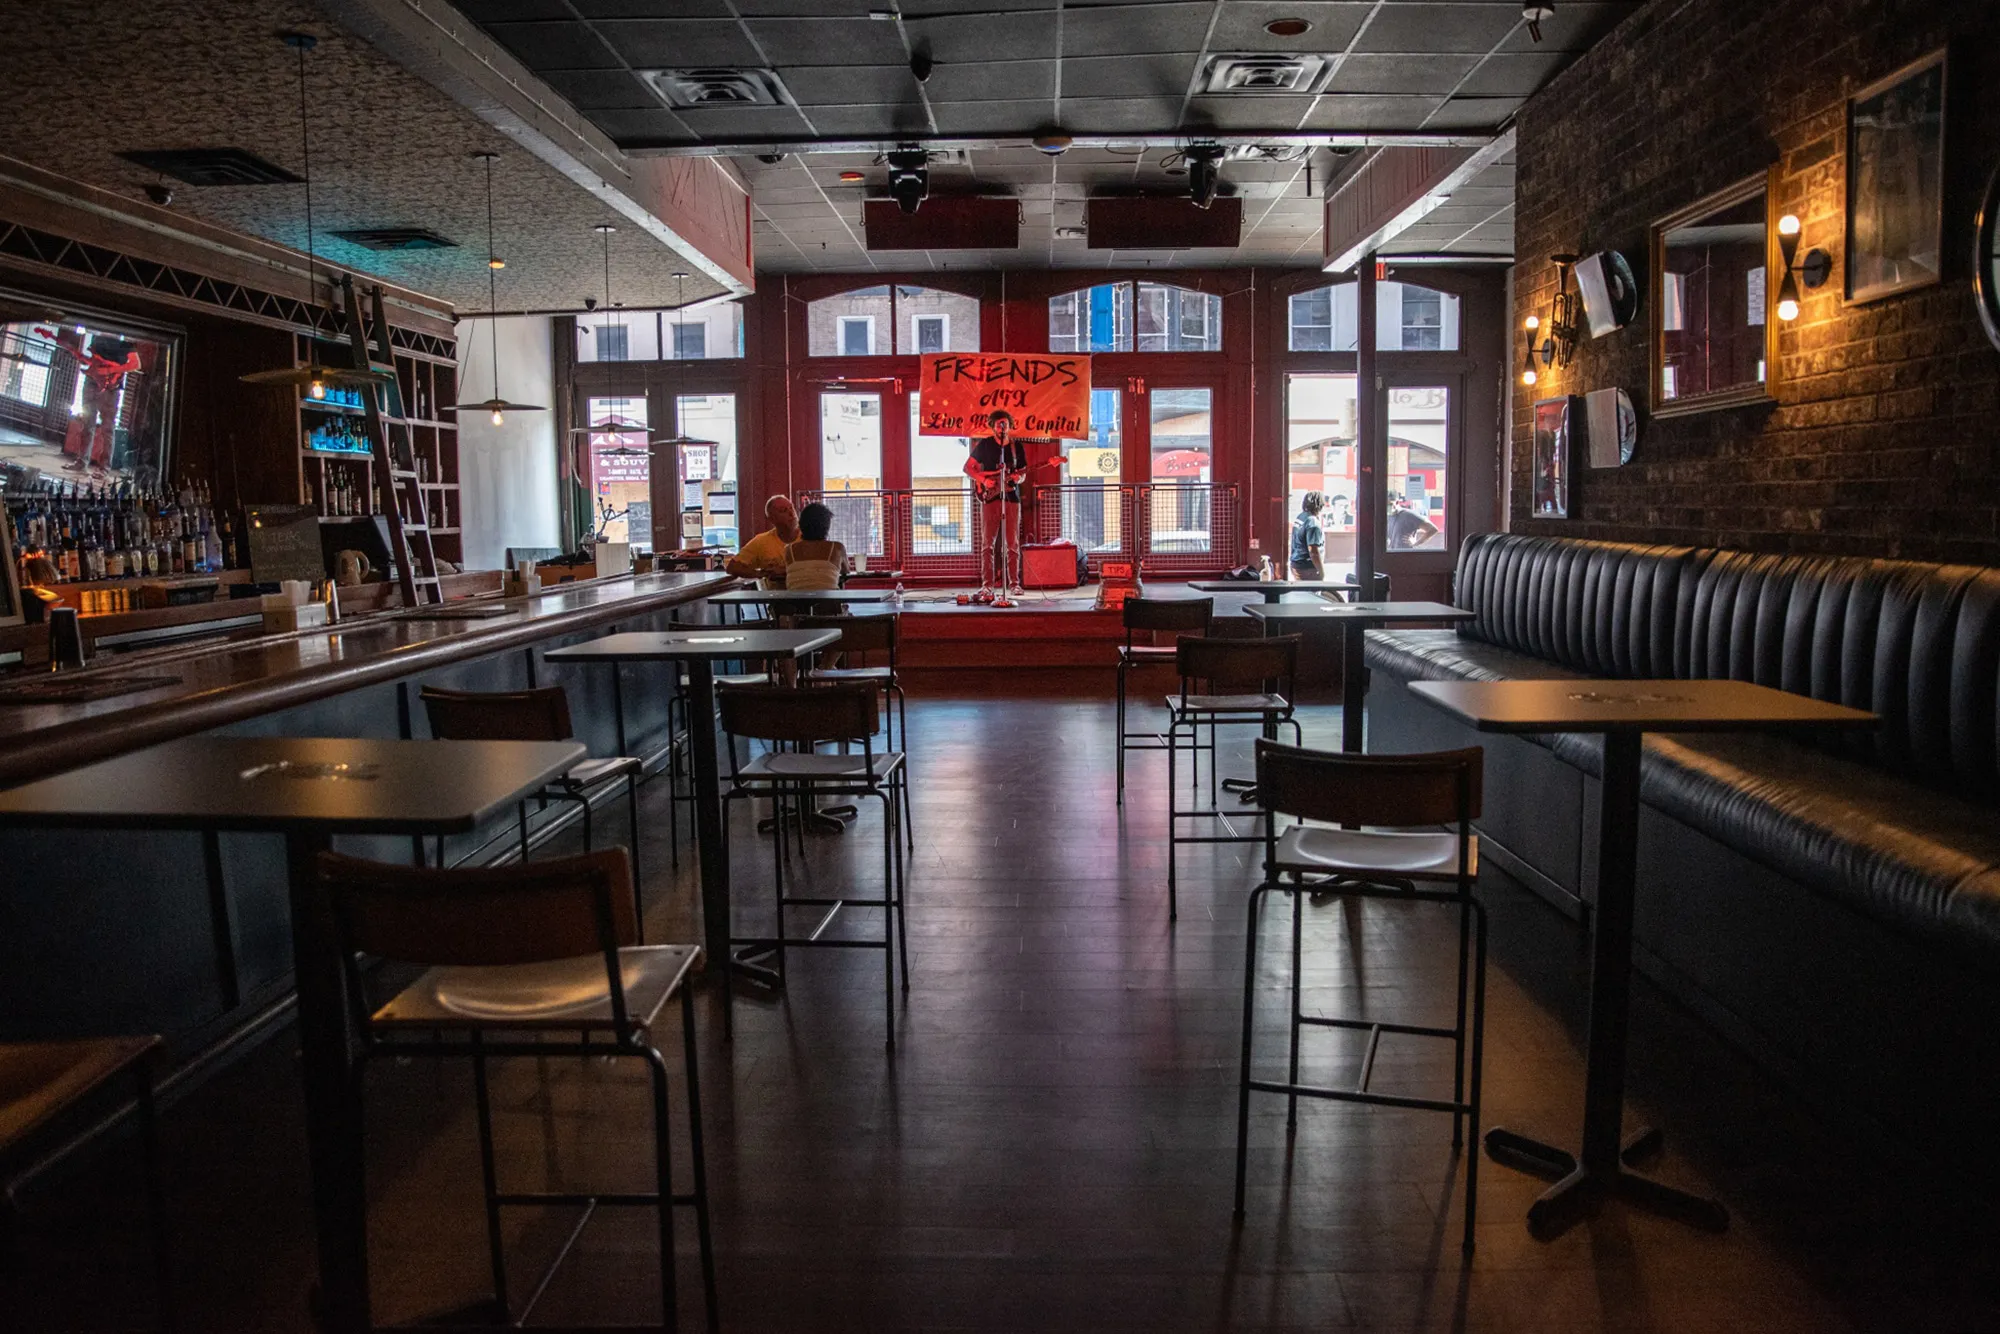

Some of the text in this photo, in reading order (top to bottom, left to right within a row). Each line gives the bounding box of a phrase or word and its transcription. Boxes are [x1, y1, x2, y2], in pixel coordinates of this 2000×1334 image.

[933, 356, 1078, 386] FRIENDS
[980, 388, 1029, 407] ATX
[928, 412, 964, 429] Live
[1025, 414, 1082, 434] Capital
[687, 449, 708, 457] SHOP
[1107, 566, 1125, 574] TIPS
